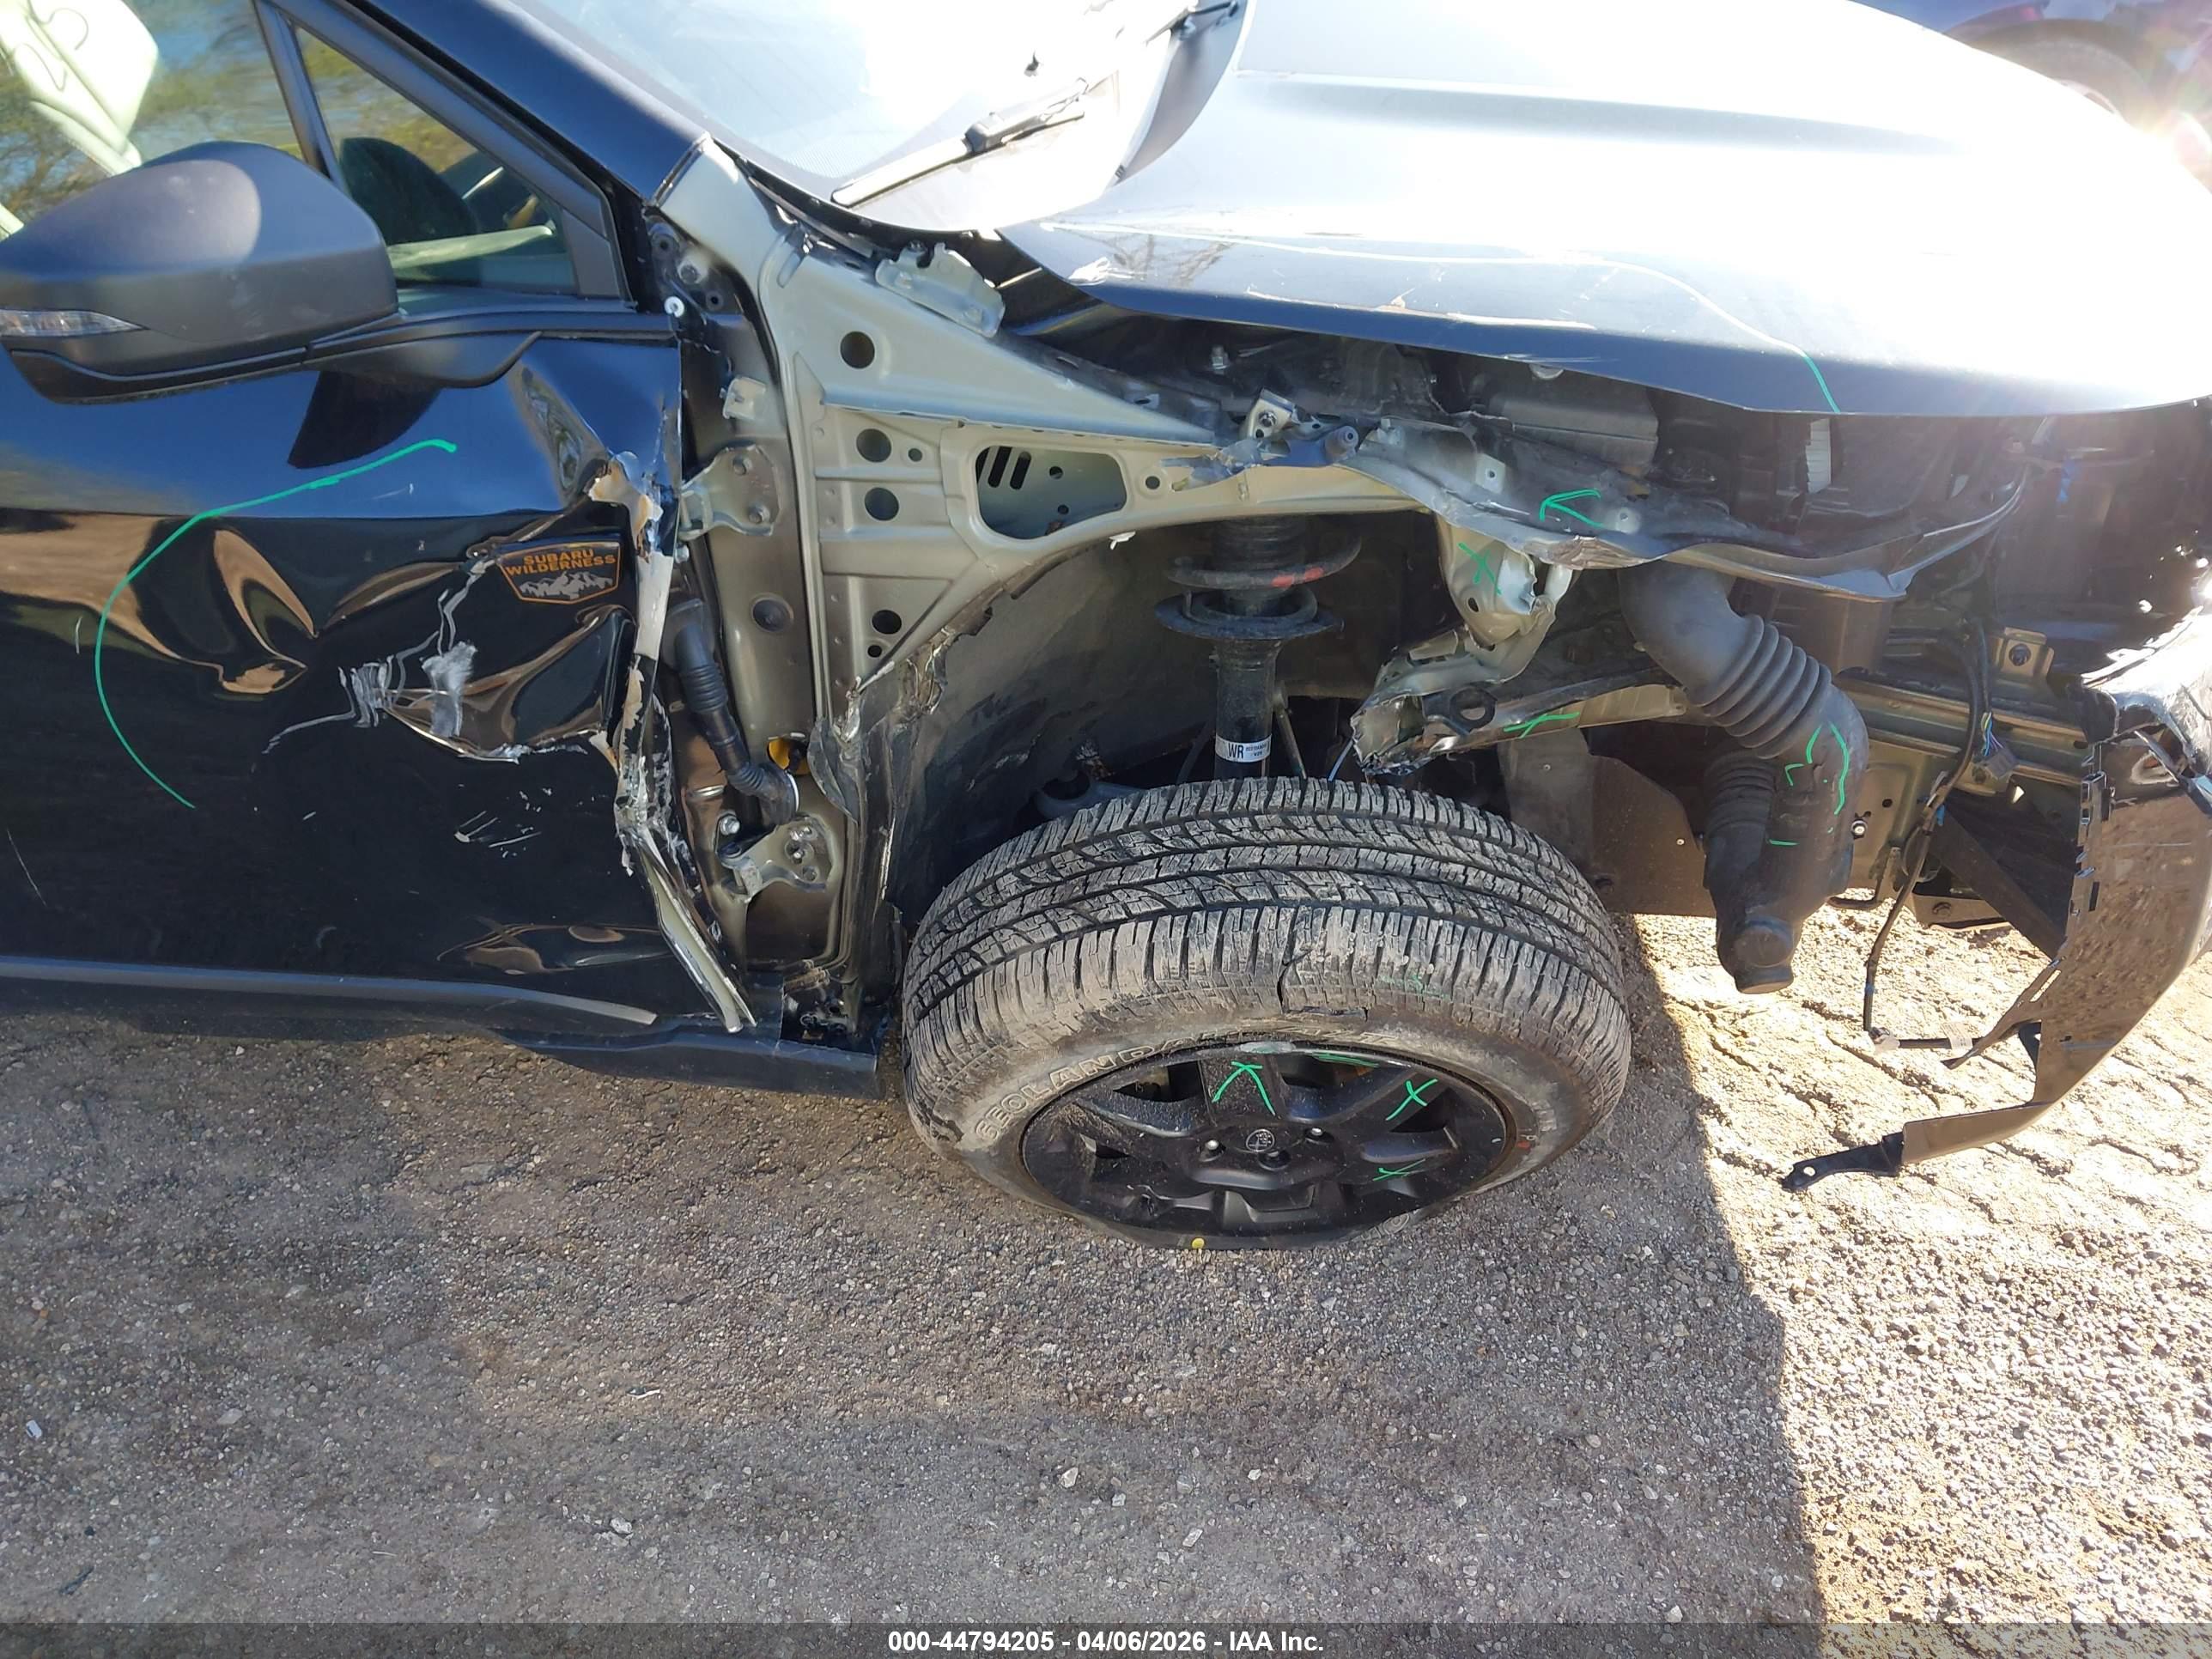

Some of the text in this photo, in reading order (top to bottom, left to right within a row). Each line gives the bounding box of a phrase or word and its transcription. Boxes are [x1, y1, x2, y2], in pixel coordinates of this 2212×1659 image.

[524, 549, 594, 565] SUBARU
[506, 555, 616, 576] WILDERNESS
[1229, 743, 1244, 759] WR
